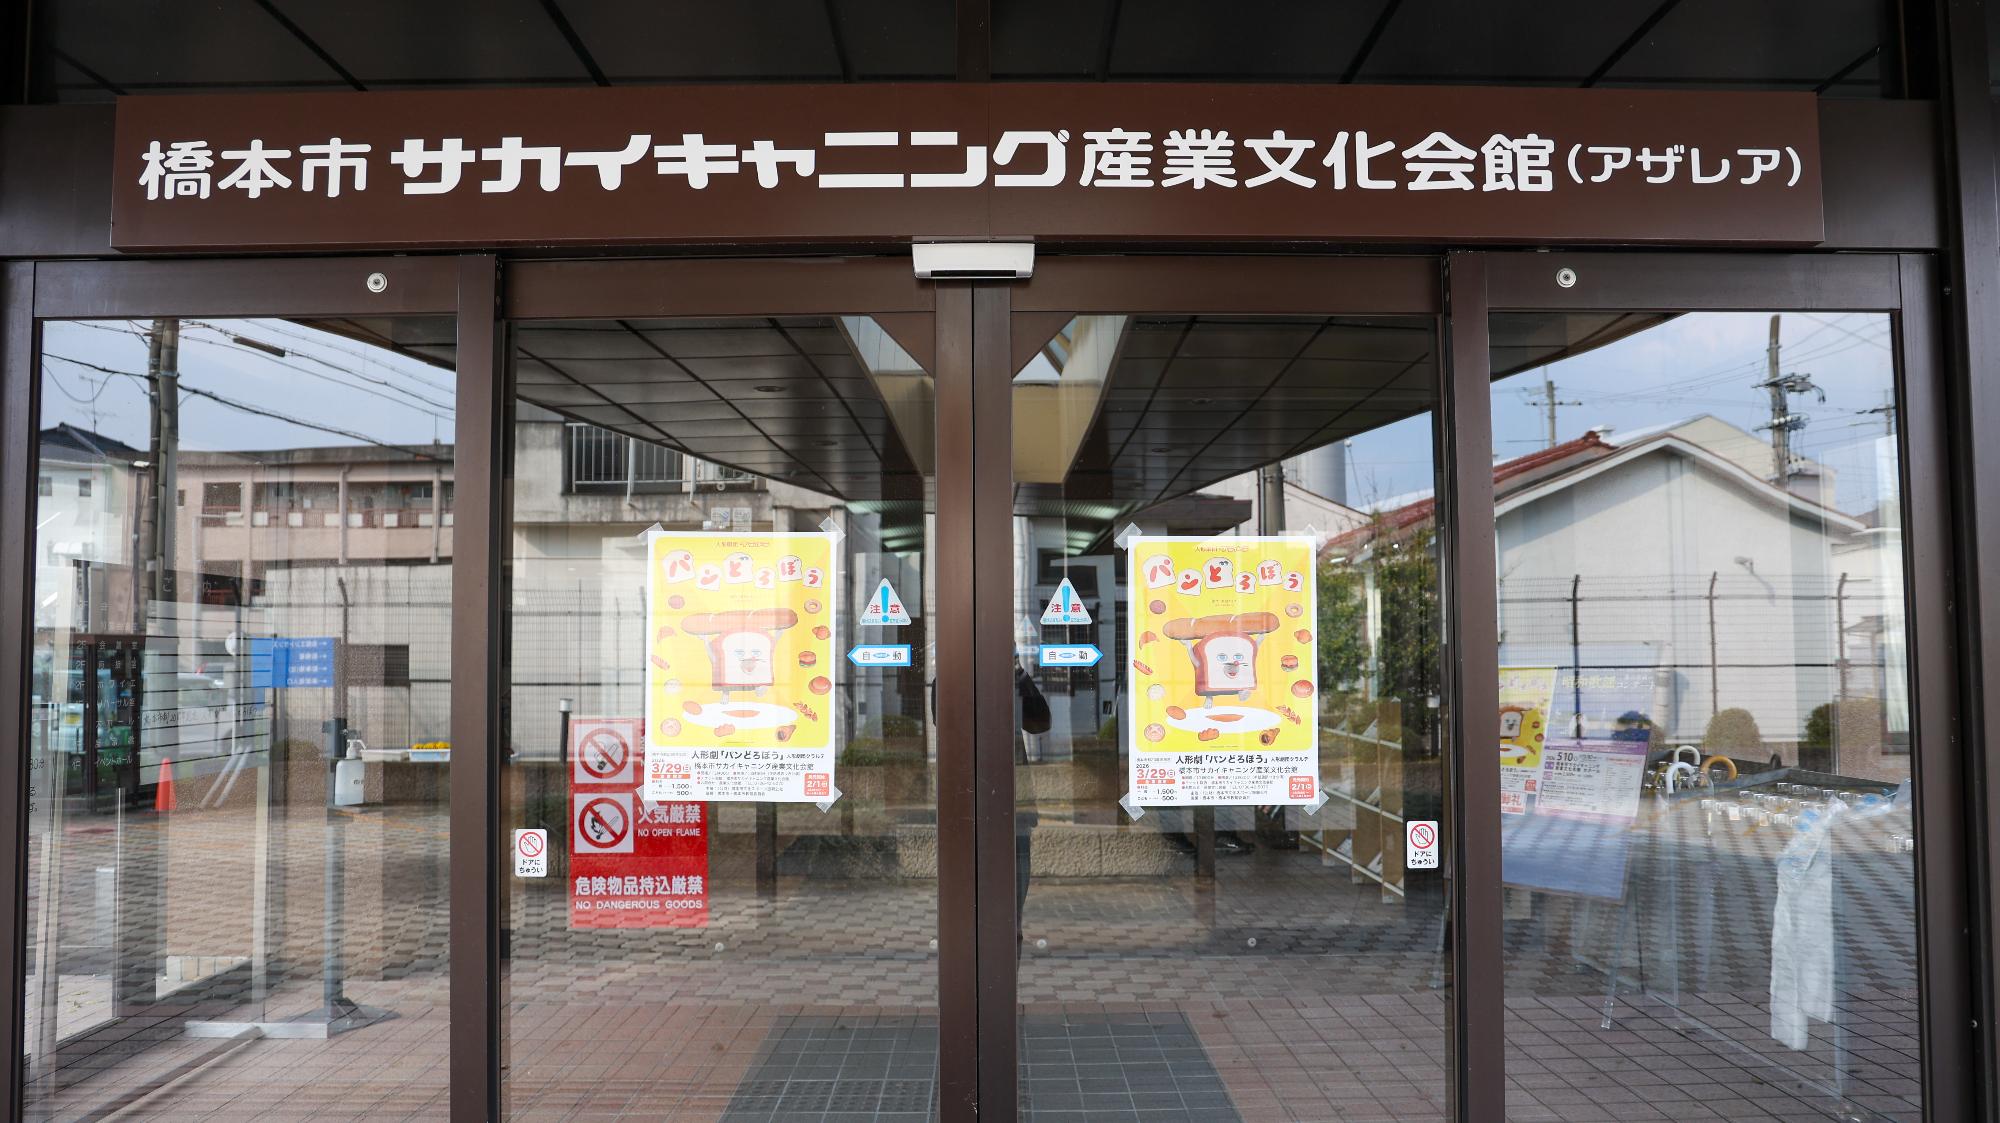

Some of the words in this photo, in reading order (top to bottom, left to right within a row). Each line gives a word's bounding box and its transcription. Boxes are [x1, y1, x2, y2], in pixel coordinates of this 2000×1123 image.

[138, 136, 372, 200] 橋本市
[391, 129, 1070, 195] サカイキャニング
[1078, 127, 1556, 193] 産業文化会館
[1567, 143, 1802, 187] （アザレア）
[1149, 558, 1299, 591] パンどろぼう
[862, 650, 902, 661] 自動
[1048, 650, 1088, 661] 自動
[637, 804, 701, 825] 火気厳禁
[637, 828, 650, 838] NO
[652, 828, 673, 837] OPEN
[675, 828, 701, 837] FLAME
[522, 858, 541, 866] ドアに
[1410, 858, 1435, 866] ちゅうい
[519, 866, 544, 874] ちゅうい
[575, 876, 704, 896] 危険物品持込厳禁
[576, 900, 591, 910] NO
[597, 900, 660, 910] DANGEROUS
[665, 900, 703, 909] GOODS
